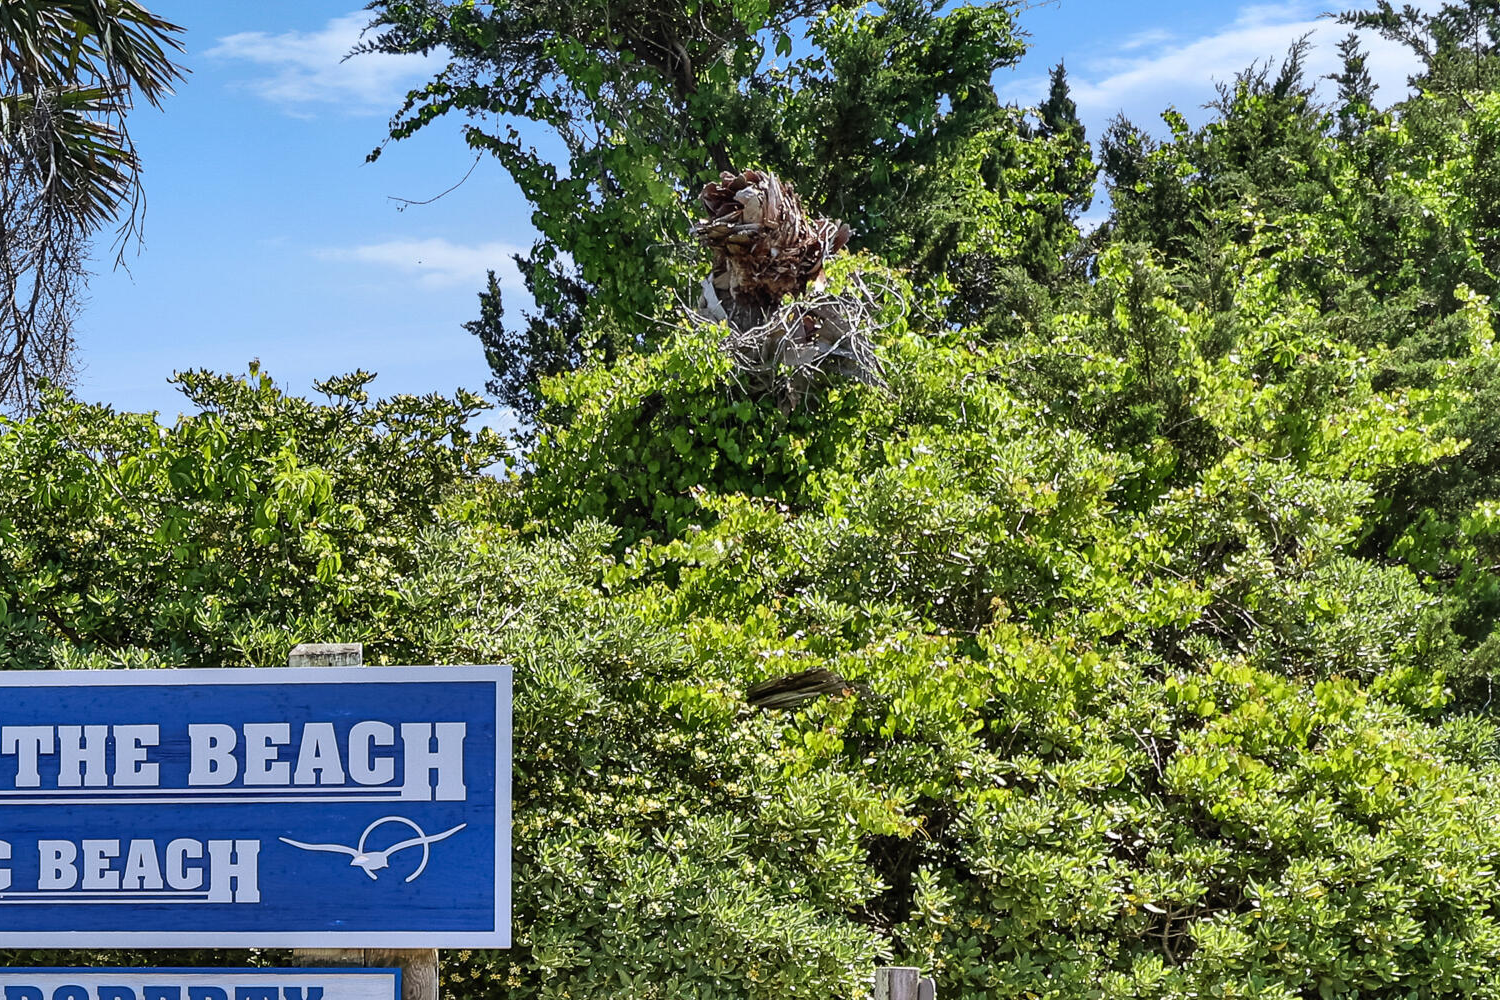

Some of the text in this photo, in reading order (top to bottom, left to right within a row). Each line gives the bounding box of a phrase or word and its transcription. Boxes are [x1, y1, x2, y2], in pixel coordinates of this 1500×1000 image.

[2, 723, 161, 787] THE
[187, 719, 468, 802] BEACH
[37, 838, 261, 904] BEACH
